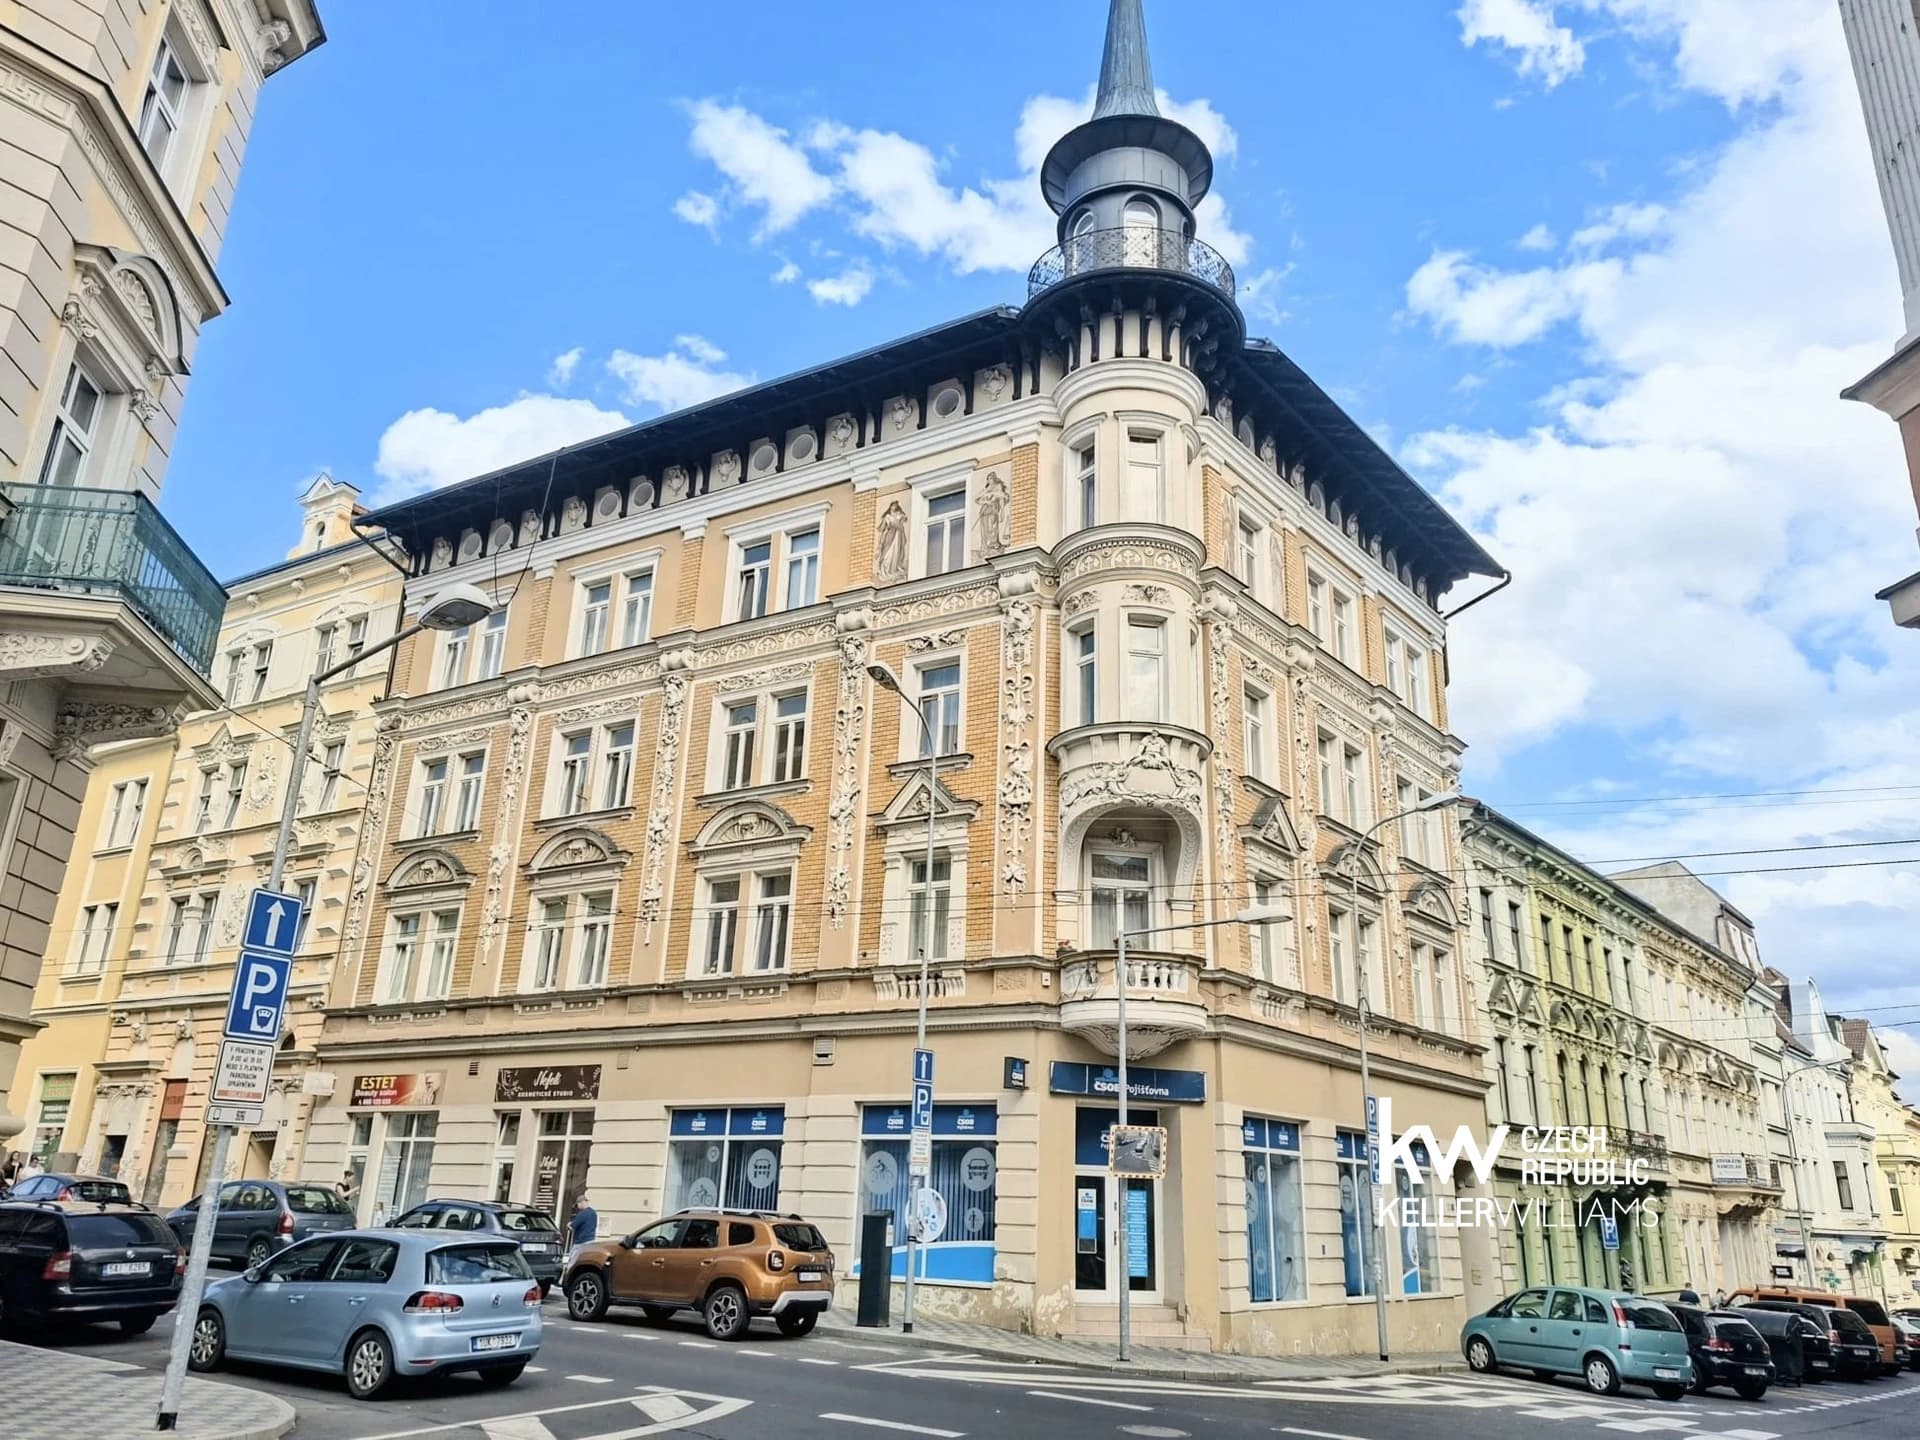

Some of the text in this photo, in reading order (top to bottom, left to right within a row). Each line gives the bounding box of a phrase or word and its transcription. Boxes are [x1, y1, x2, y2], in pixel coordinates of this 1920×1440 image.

[242, 963, 278, 1010] P
[361, 1077, 397, 1089] ESTET
[1126, 1083, 1169, 1096] Pojišťovna
[355, 1089, 378, 1097] Beauty
[917, 1089, 929, 1114] P
[1368, 1100, 1376, 1118] P
